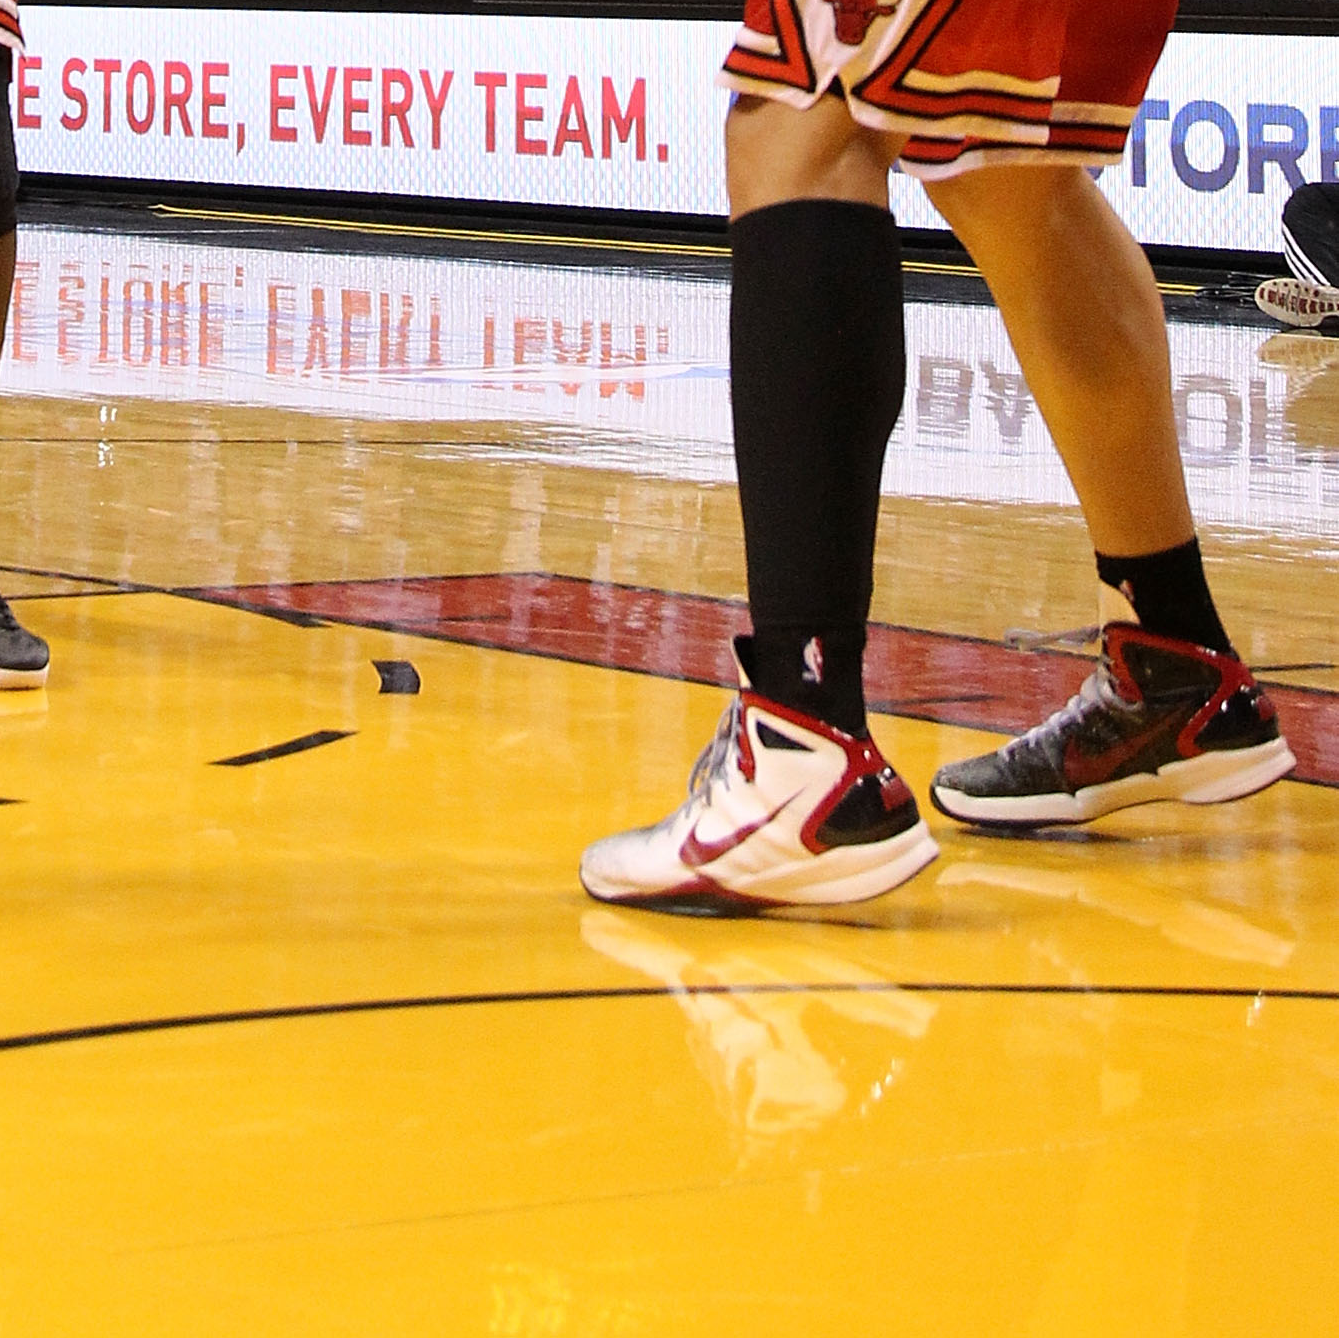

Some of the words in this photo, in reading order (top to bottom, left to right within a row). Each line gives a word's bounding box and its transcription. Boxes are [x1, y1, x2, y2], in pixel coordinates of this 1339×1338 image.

[60, 58, 245, 156] STORE,
[269, 64, 454, 151] EVERY
[474, 71, 670, 164] TEAM.
